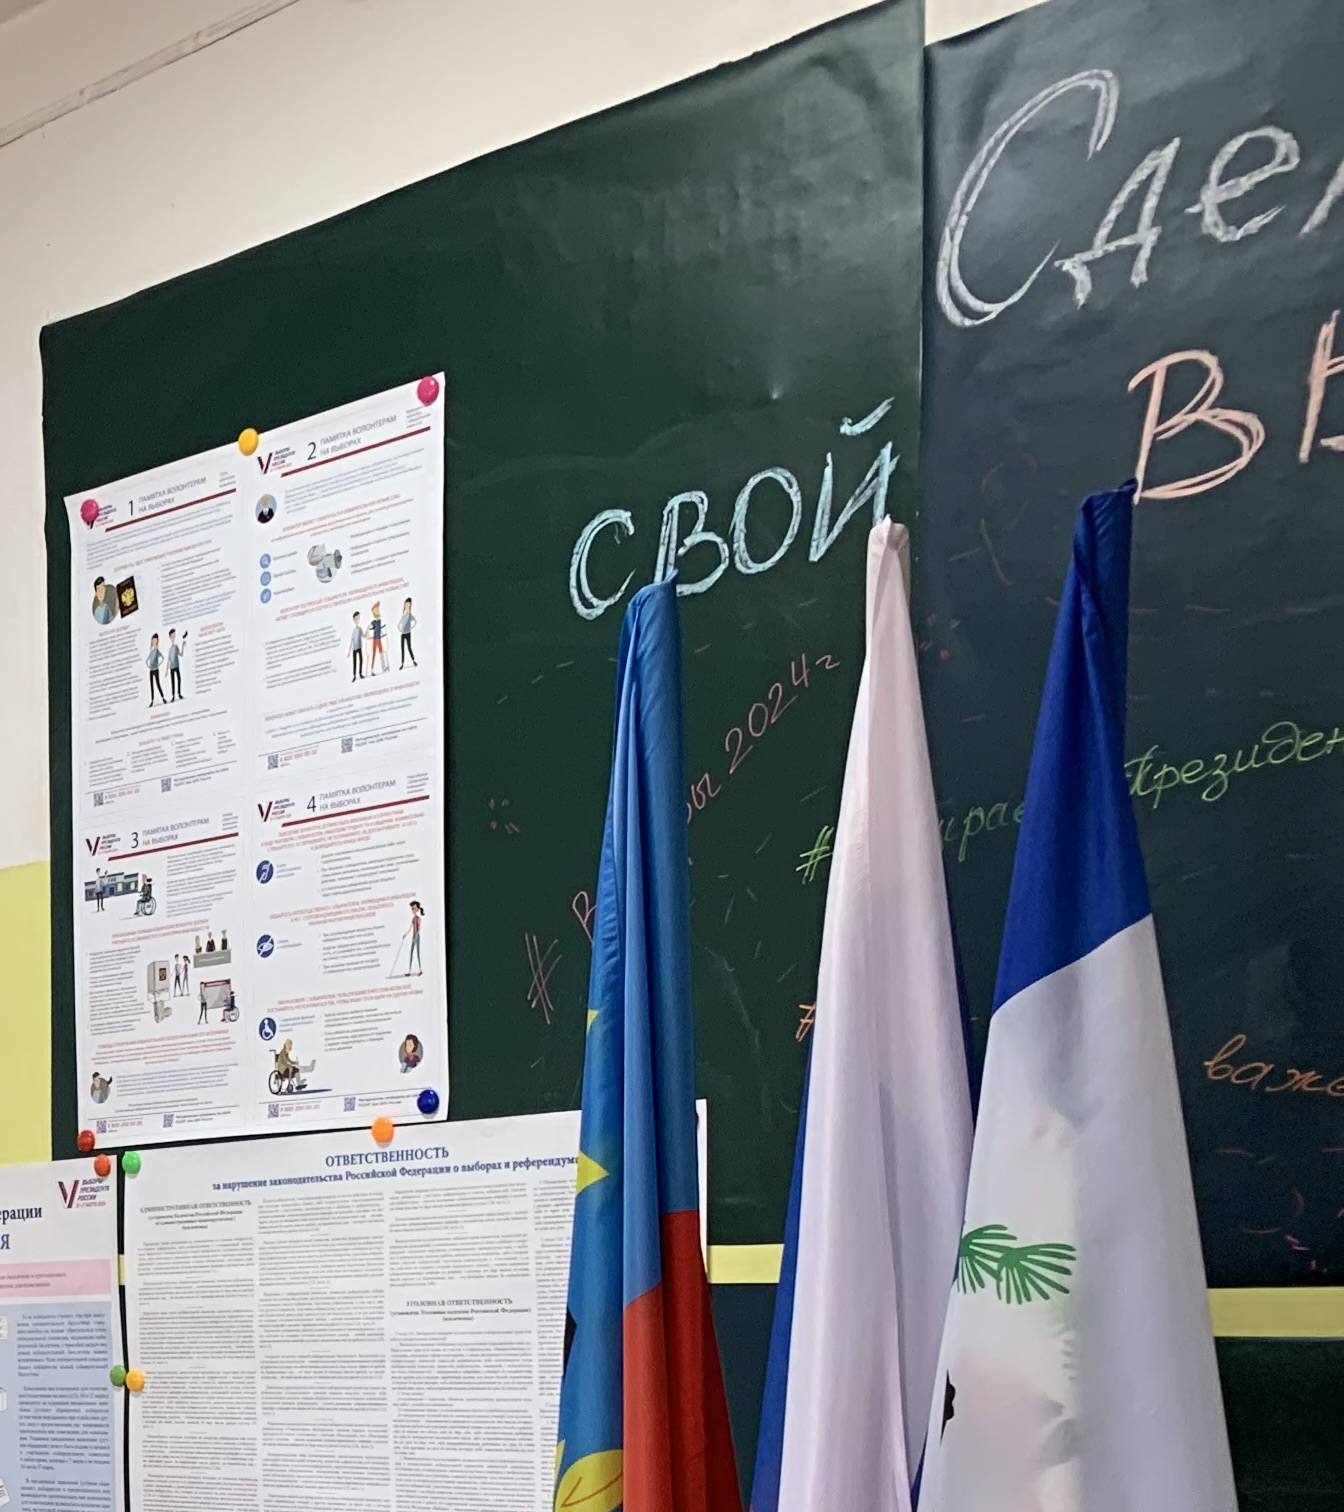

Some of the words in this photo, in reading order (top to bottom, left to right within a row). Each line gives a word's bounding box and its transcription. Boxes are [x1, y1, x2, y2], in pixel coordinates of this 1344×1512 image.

[936, 67, 1344, 328] Сде
[307, 441, 317, 461] 2
[320, 430, 351, 446] ПАМЯТКА
[352, 415, 397, 436] ВОЛОНТЕРАМ
[320, 448, 330, 457] НА
[330, 438, 361, 455] ВЫБОРАХ
[128, 500, 134, 516] 1
[138, 490, 166, 504] ПАМЯТКА
[166, 477, 207, 495] ВОЛОНТЕРАМ
[138, 505, 147, 514] НА
[148, 497, 175, 512] ВЫБОРАХ
[306, 795, 317, 813] 4
[319, 788, 351, 801] ПАМЯТКА
[351, 779, 396, 795] ВОЛОНТЕРАМ
[319, 803, 329, 811] НА
[330, 797, 361, 810] ВЫБОРАХ
[130, 831, 139, 849] 3
[142, 824, 169, 837] ПАМЯТКА
[170, 817, 210, 831] ВОЛОНТЕРАМ
[142, 838, 151, 847] НА
[151, 833, 179, 845] ВЫБОРАХ
[325, 1146, 449, 1168] ОТВЕТСТВЕННОСТЬ
[222, 1178, 268, 1192] нарушение
[268, 1173, 343, 1187] законодательства
[345, 1167, 397, 1181] Российской
[399, 1165, 451, 1178] Федерации
[461, 1161, 502, 1175] выборах
